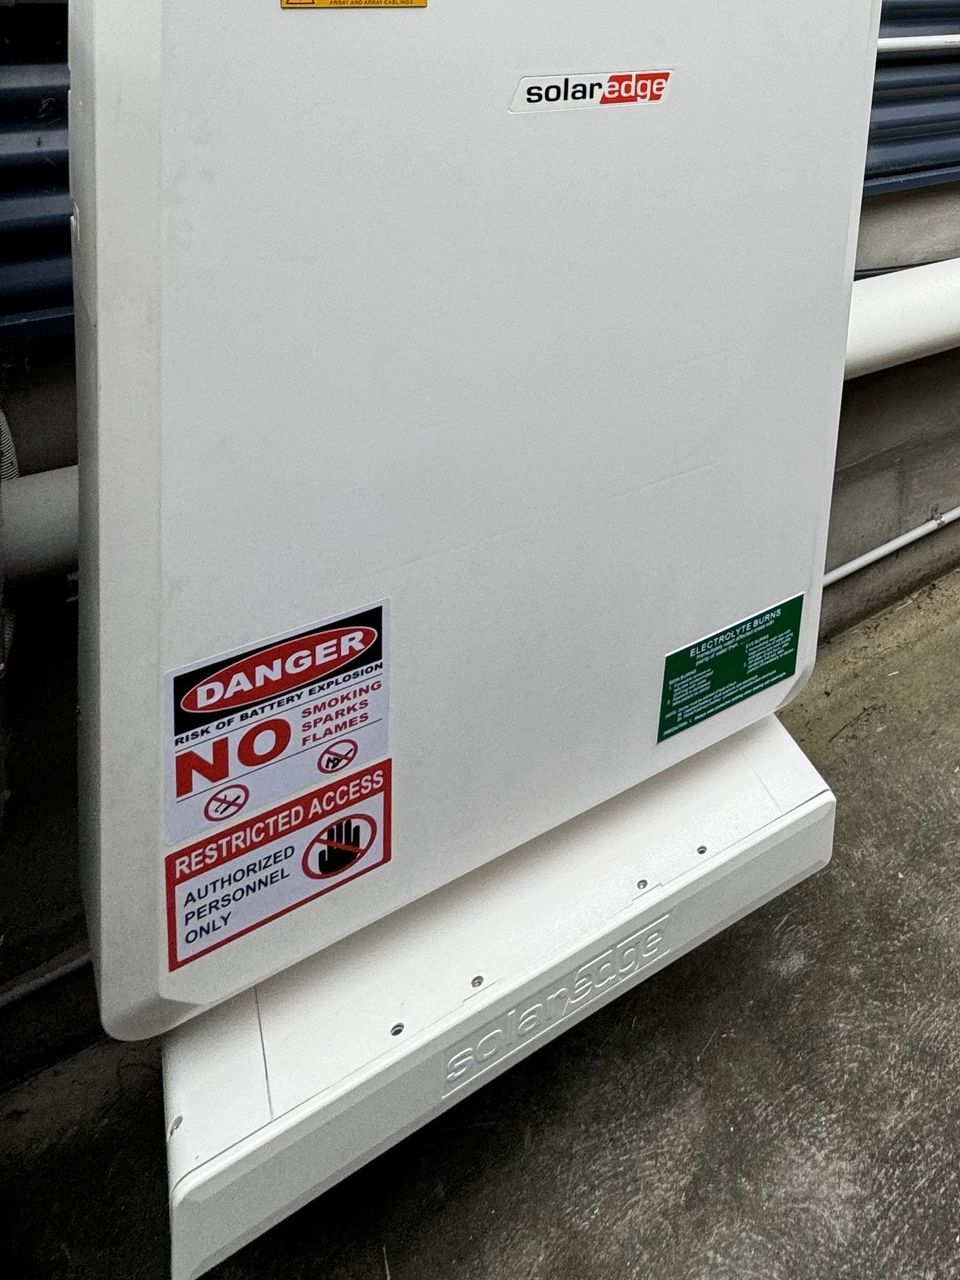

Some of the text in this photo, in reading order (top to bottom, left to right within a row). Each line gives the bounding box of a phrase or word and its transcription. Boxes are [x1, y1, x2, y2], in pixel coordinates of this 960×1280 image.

[526, 74, 669, 104] solaredge
[690, 622, 752, 658] ELECTROLYTE
[753, 608, 782, 628] BURNS
[197, 630, 366, 709] DANGER
[175, 662, 384, 746] RISK OF BATTERY EXPLOSION
[302, 680, 382, 718] SMOKING
[302, 700, 368, 732] SPARKS
[302, 713, 369, 746] FLAMES
[176, 718, 292, 798] NO
[175, 770, 384, 878] RESTRICTED ACCESS
[184, 845, 296, 908] AUTHORIZED
[184, 868, 290, 926] PERSONNEL
[184, 912, 232, 944] ONLY
